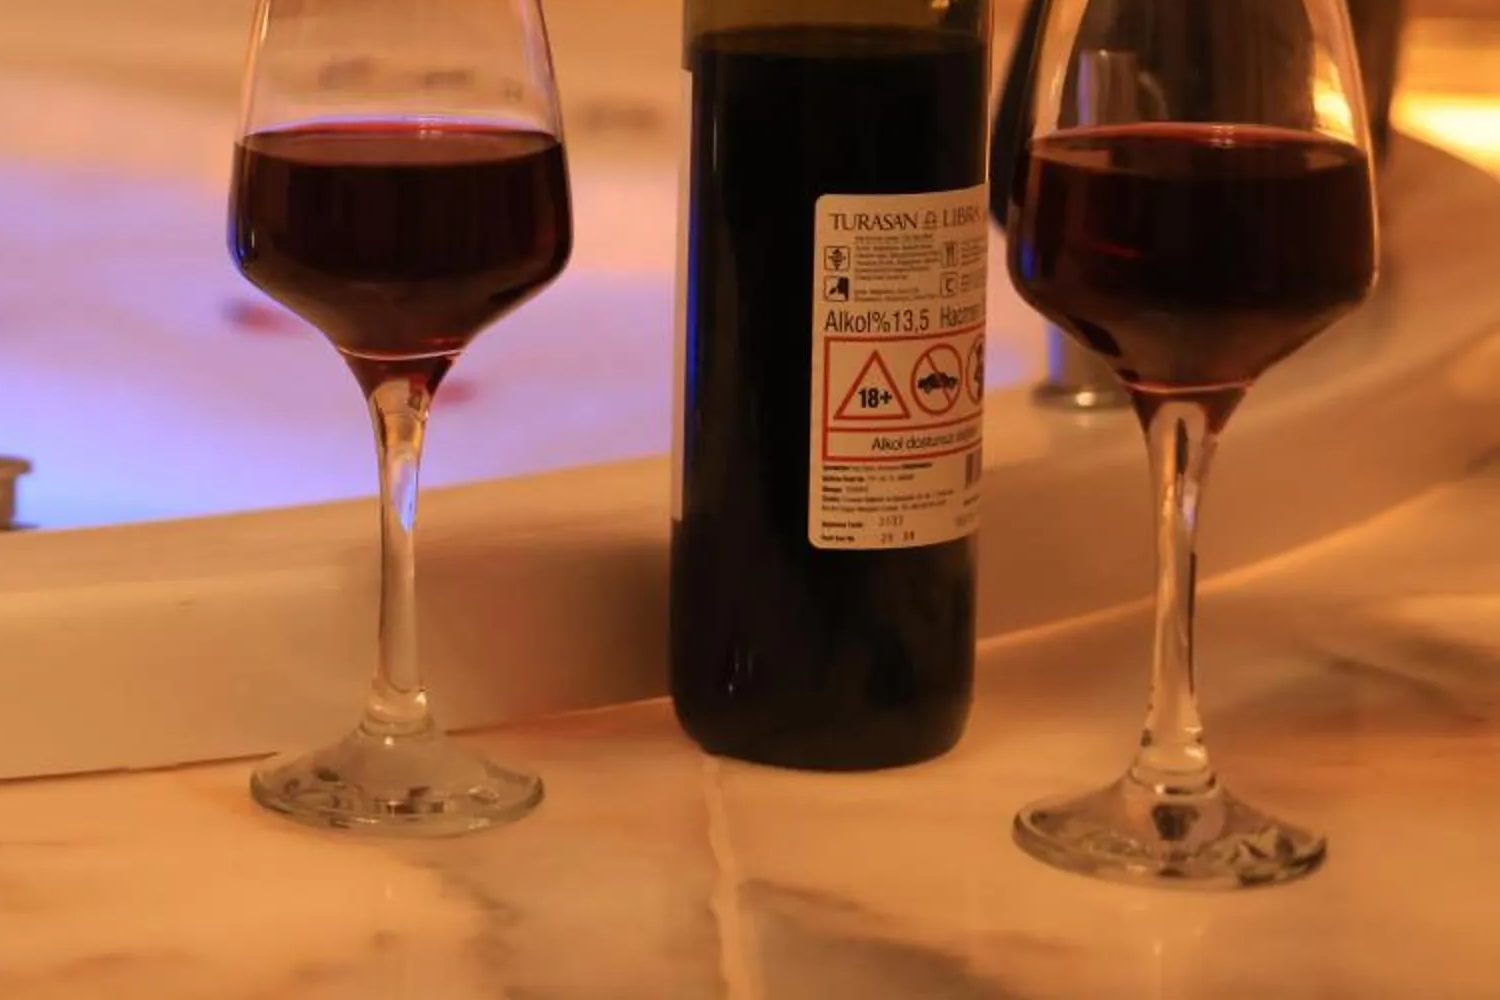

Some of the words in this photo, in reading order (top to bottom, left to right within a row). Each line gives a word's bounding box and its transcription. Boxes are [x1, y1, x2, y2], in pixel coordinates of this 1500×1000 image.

[829, 211, 918, 231] TURASAN
[857, 387, 893, 409] 18+
[871, 436, 903, 452] Alkol
